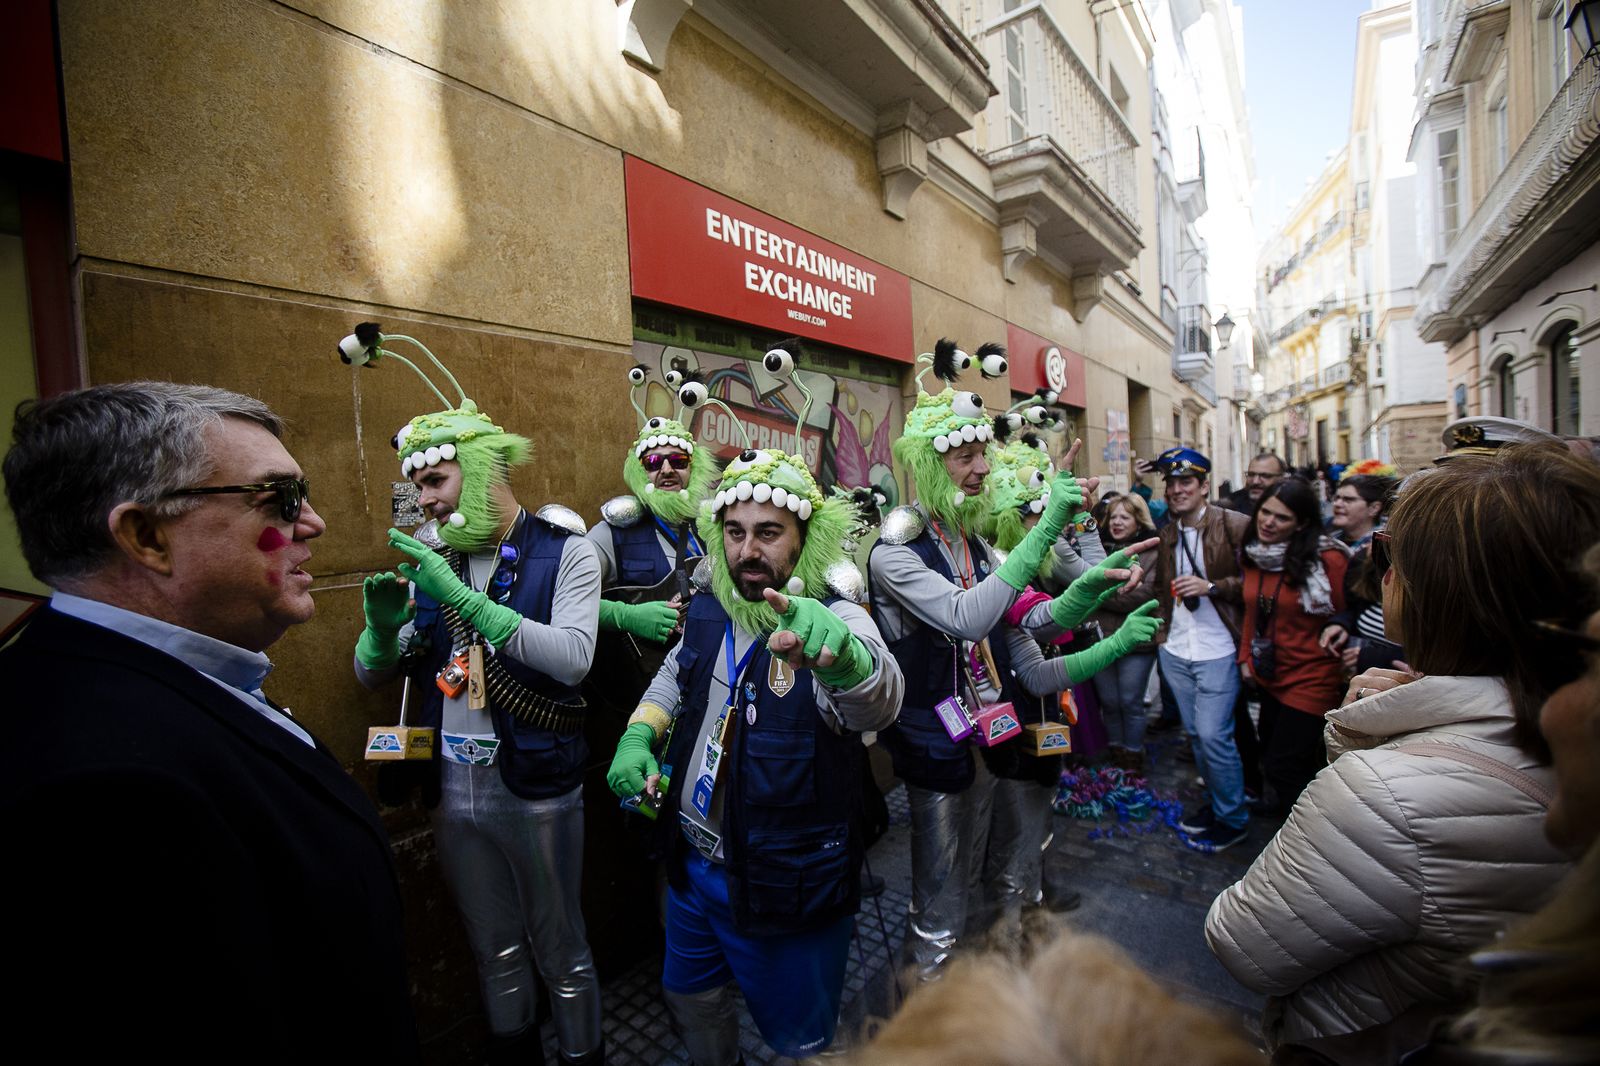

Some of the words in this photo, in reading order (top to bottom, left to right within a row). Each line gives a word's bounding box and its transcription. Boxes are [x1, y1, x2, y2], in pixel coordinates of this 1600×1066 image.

[706, 208, 876, 295] ENTERTAINMENT
[745, 262, 852, 319] EXCHANGE
[787, 309, 826, 327] WEBUY.COM
